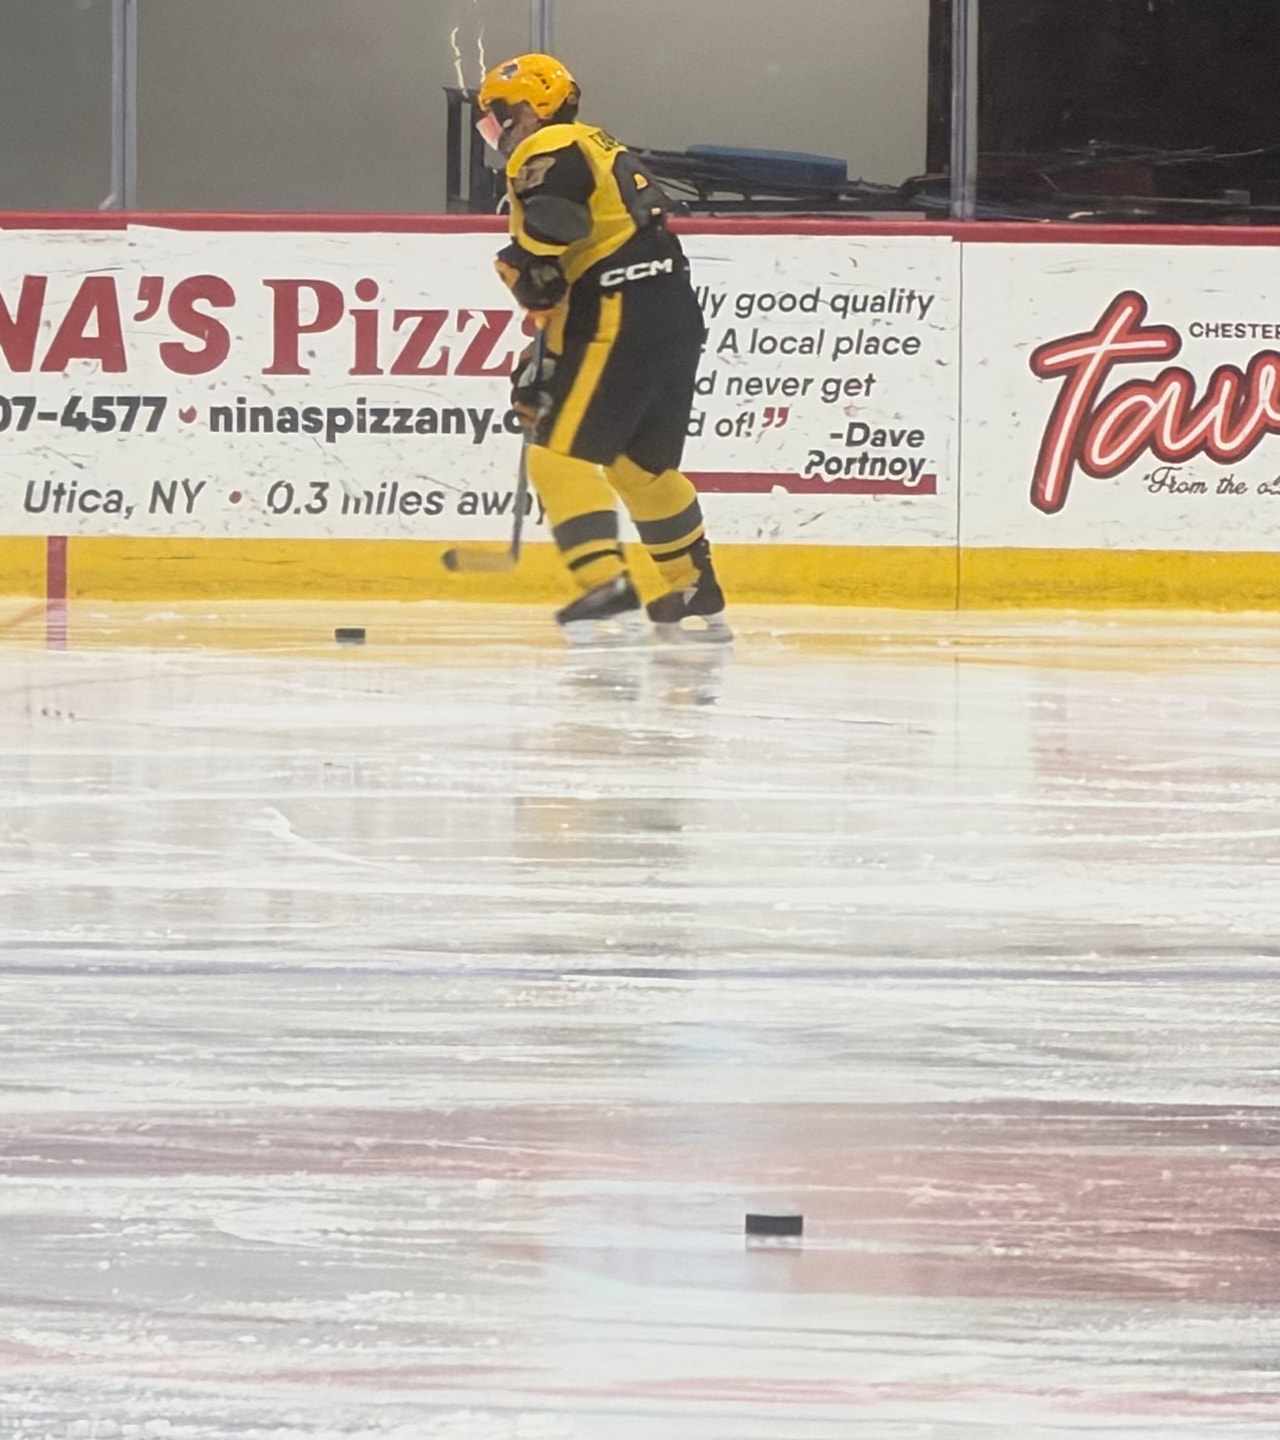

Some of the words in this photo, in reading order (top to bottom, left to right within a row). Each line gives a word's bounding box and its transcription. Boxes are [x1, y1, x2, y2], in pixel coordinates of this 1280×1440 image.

[600, 258, 673, 288] CCM
[735, 287, 820, 319] good
[830, 288, 934, 320] quality
[261, 277, 536, 376] Pizz
[716, 328, 739, 354] A
[750, 328, 826, 356] local
[832, 329, 922, 361] place
[726, 377, 814, 397] never
[821, 373, 876, 403] get
[830, 422, 925, 448] -Dave
[805, 450, 926, 482] Portnoy
[23, 480, 134, 520] Utica,
[148, 480, 206, 514] NY
[266, 481, 330, 514] 0.3
[340, 482, 444, 516] miles
[1216, 473, 1248, 495] the
